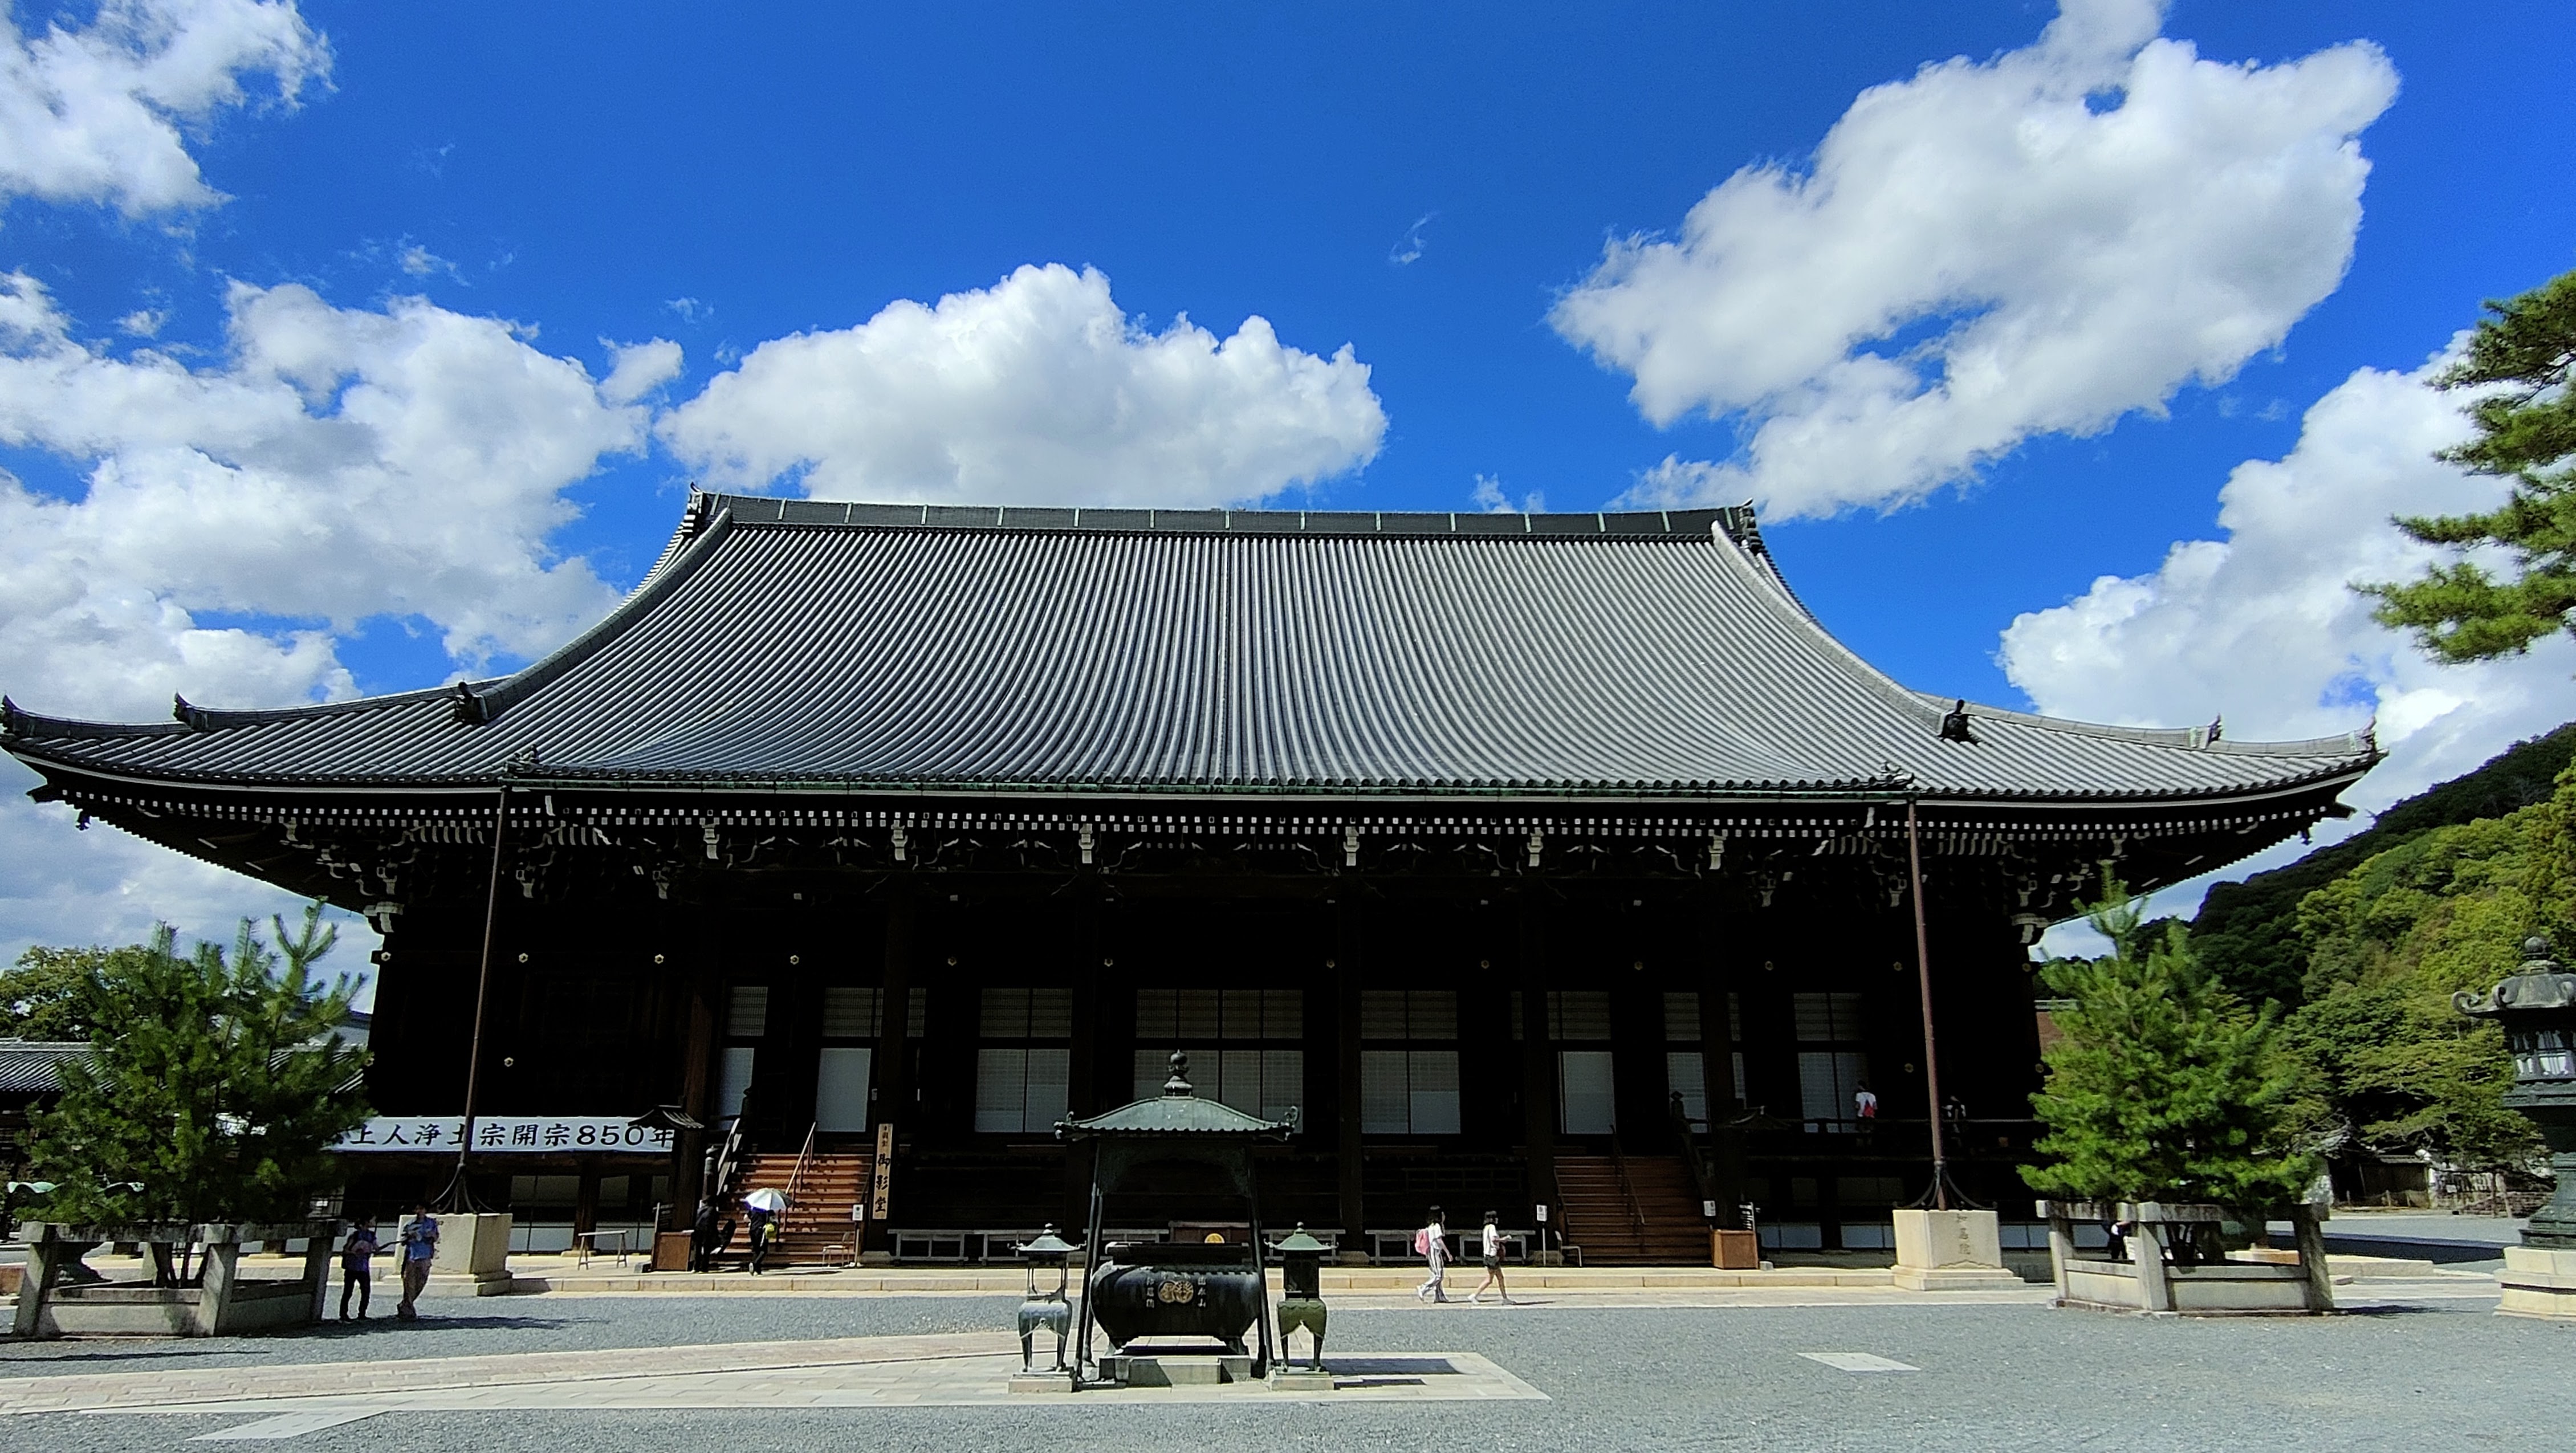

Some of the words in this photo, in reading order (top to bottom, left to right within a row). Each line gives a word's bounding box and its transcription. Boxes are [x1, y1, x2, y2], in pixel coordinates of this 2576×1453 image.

[331, 1123, 674, 1147] 上人浄土宗開宗850年
[875, 1153, 891, 1212] 御影堂
